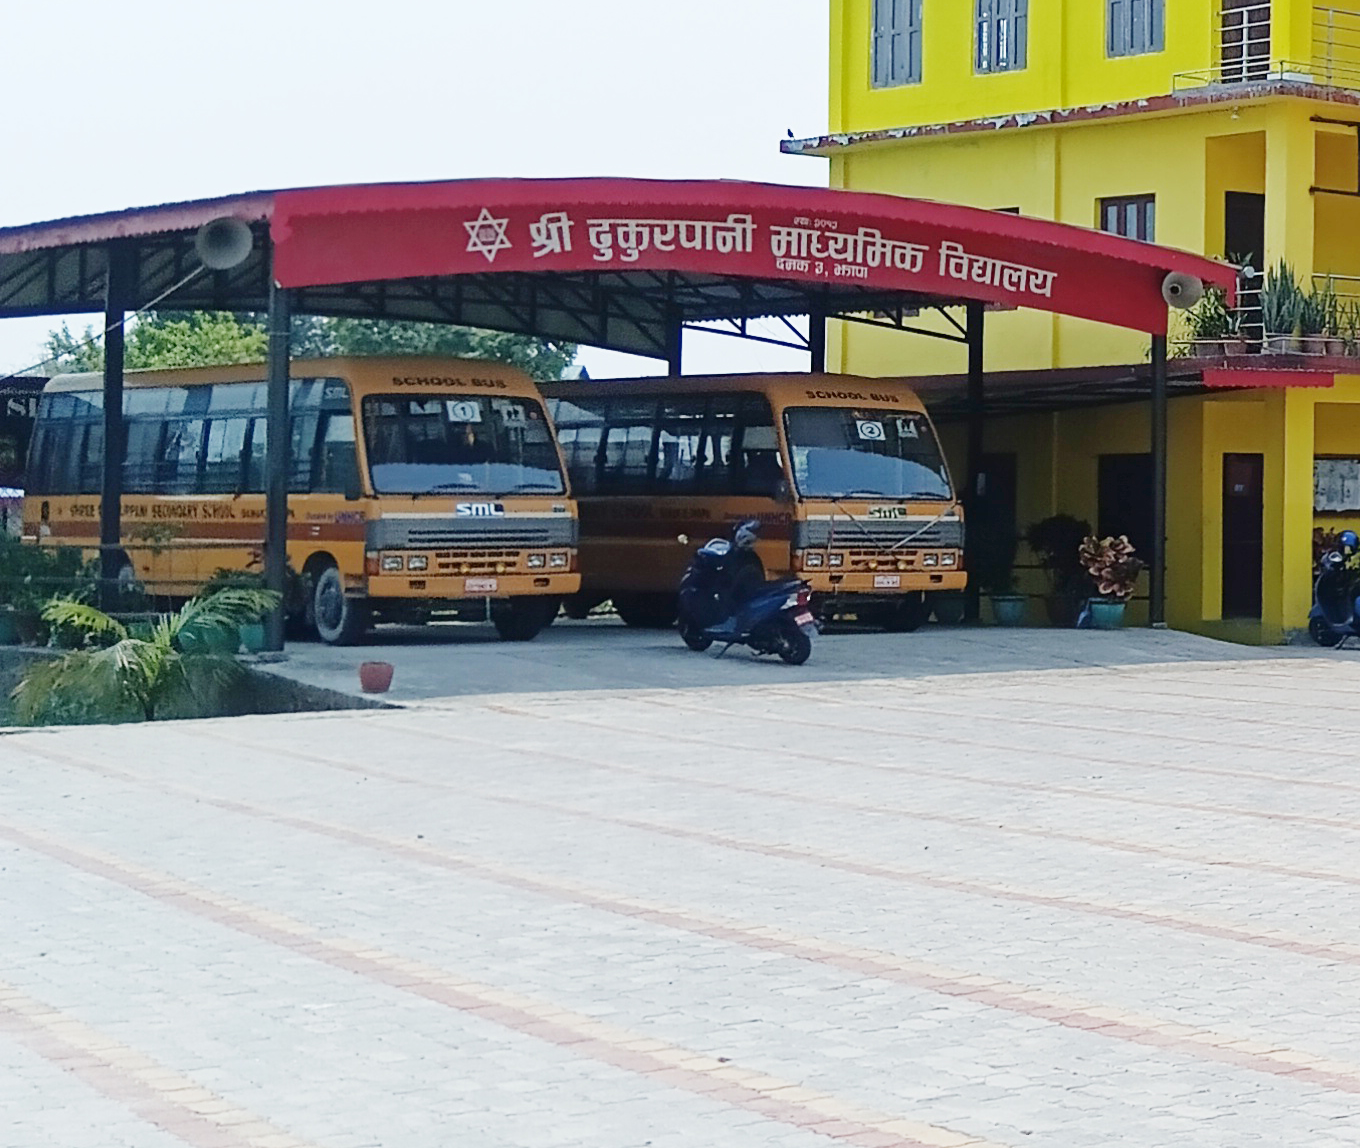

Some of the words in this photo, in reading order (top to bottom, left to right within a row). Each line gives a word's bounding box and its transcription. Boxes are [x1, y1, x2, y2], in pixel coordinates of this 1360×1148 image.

[529, 211, 575, 258] श्री
[769, 225, 930, 274] माध्यमिक
[938, 240, 1058, 298] विद्यालय
[392, 376, 467, 388] SCHOOL
[470, 378, 508, 390] BUS
[805, 389, 867, 401] SCHOOL
[869, 392, 900, 403] BUS
[201, 503, 237, 520] SCHOOL
[456, 502, 505, 517] SML
